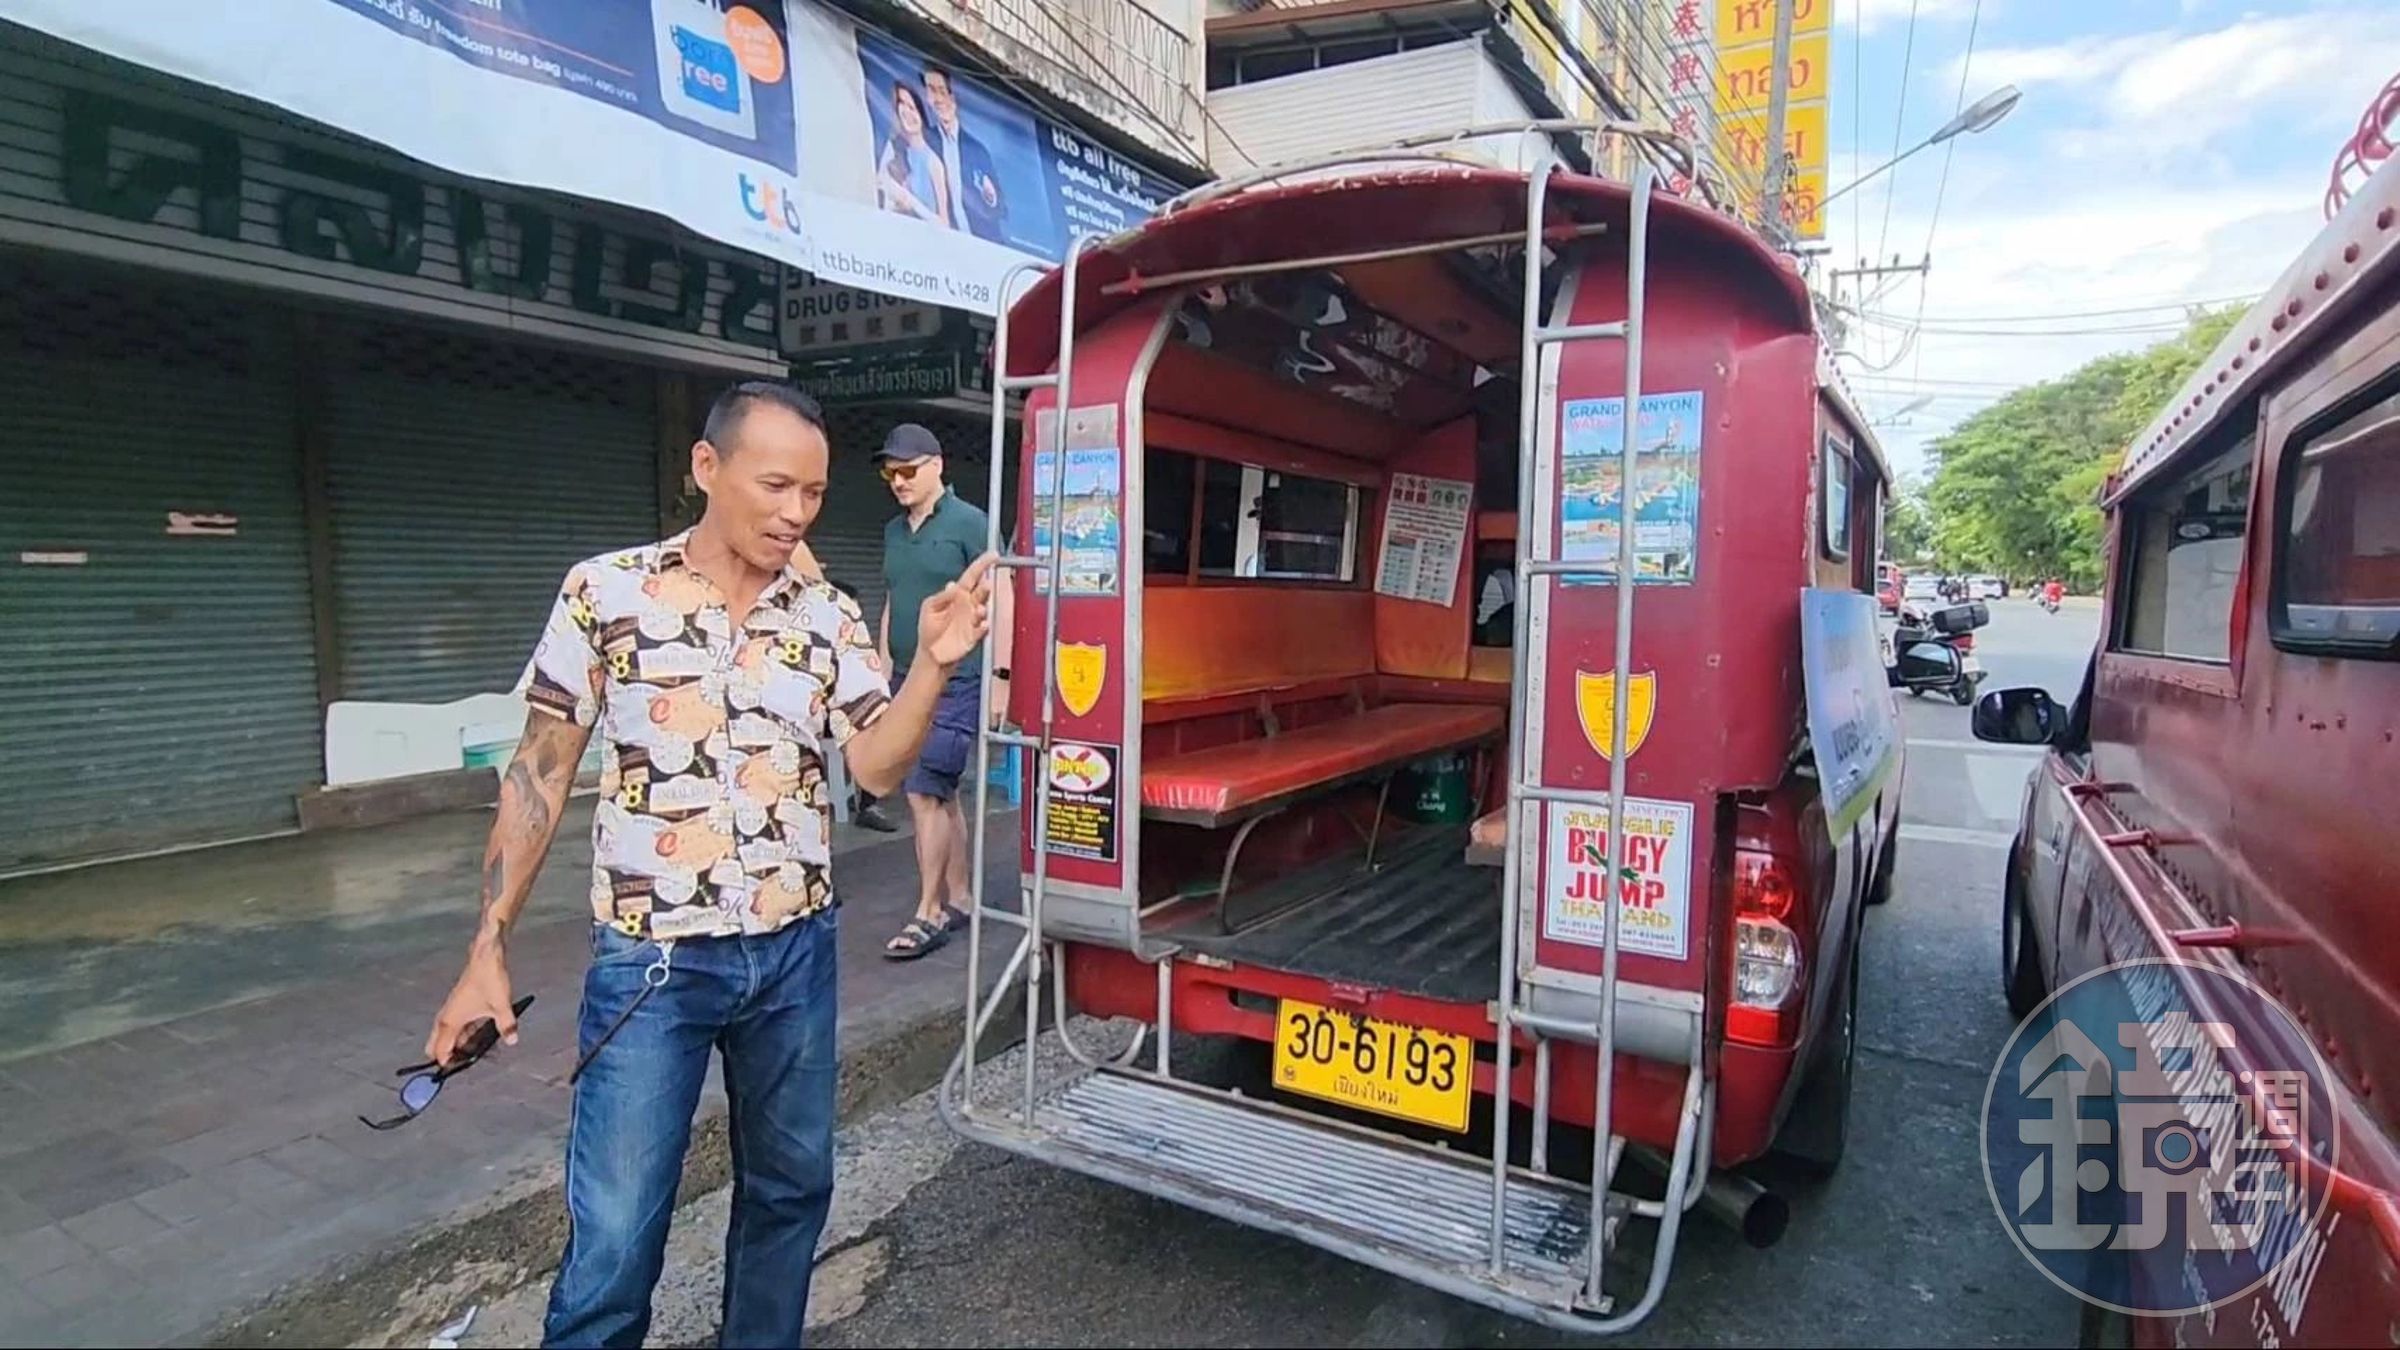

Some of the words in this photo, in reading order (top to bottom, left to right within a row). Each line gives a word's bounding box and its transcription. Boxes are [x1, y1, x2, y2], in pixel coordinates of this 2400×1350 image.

[498, 46, 530, 67] tote
[532, 54, 562, 78] bag
[1051, 127, 1080, 158] ttb
[1084, 144, 1106, 170] all
[1108, 157, 1141, 187] free
[739, 172, 802, 236] ttb
[822, 250, 939, 292] ttbbank.com
[786, 290, 849, 320] DRUG
[1569, 403, 1621, 418] GRAND
[1639, 397, 1693, 413] ANYON
[1568, 827, 1668, 874] BUGY
[1560, 899, 1672, 929] THAAND
[1288, 1013, 1457, 1092] 30-6193
[1333, 1075, 1400, 1106] เชียงใหม่
